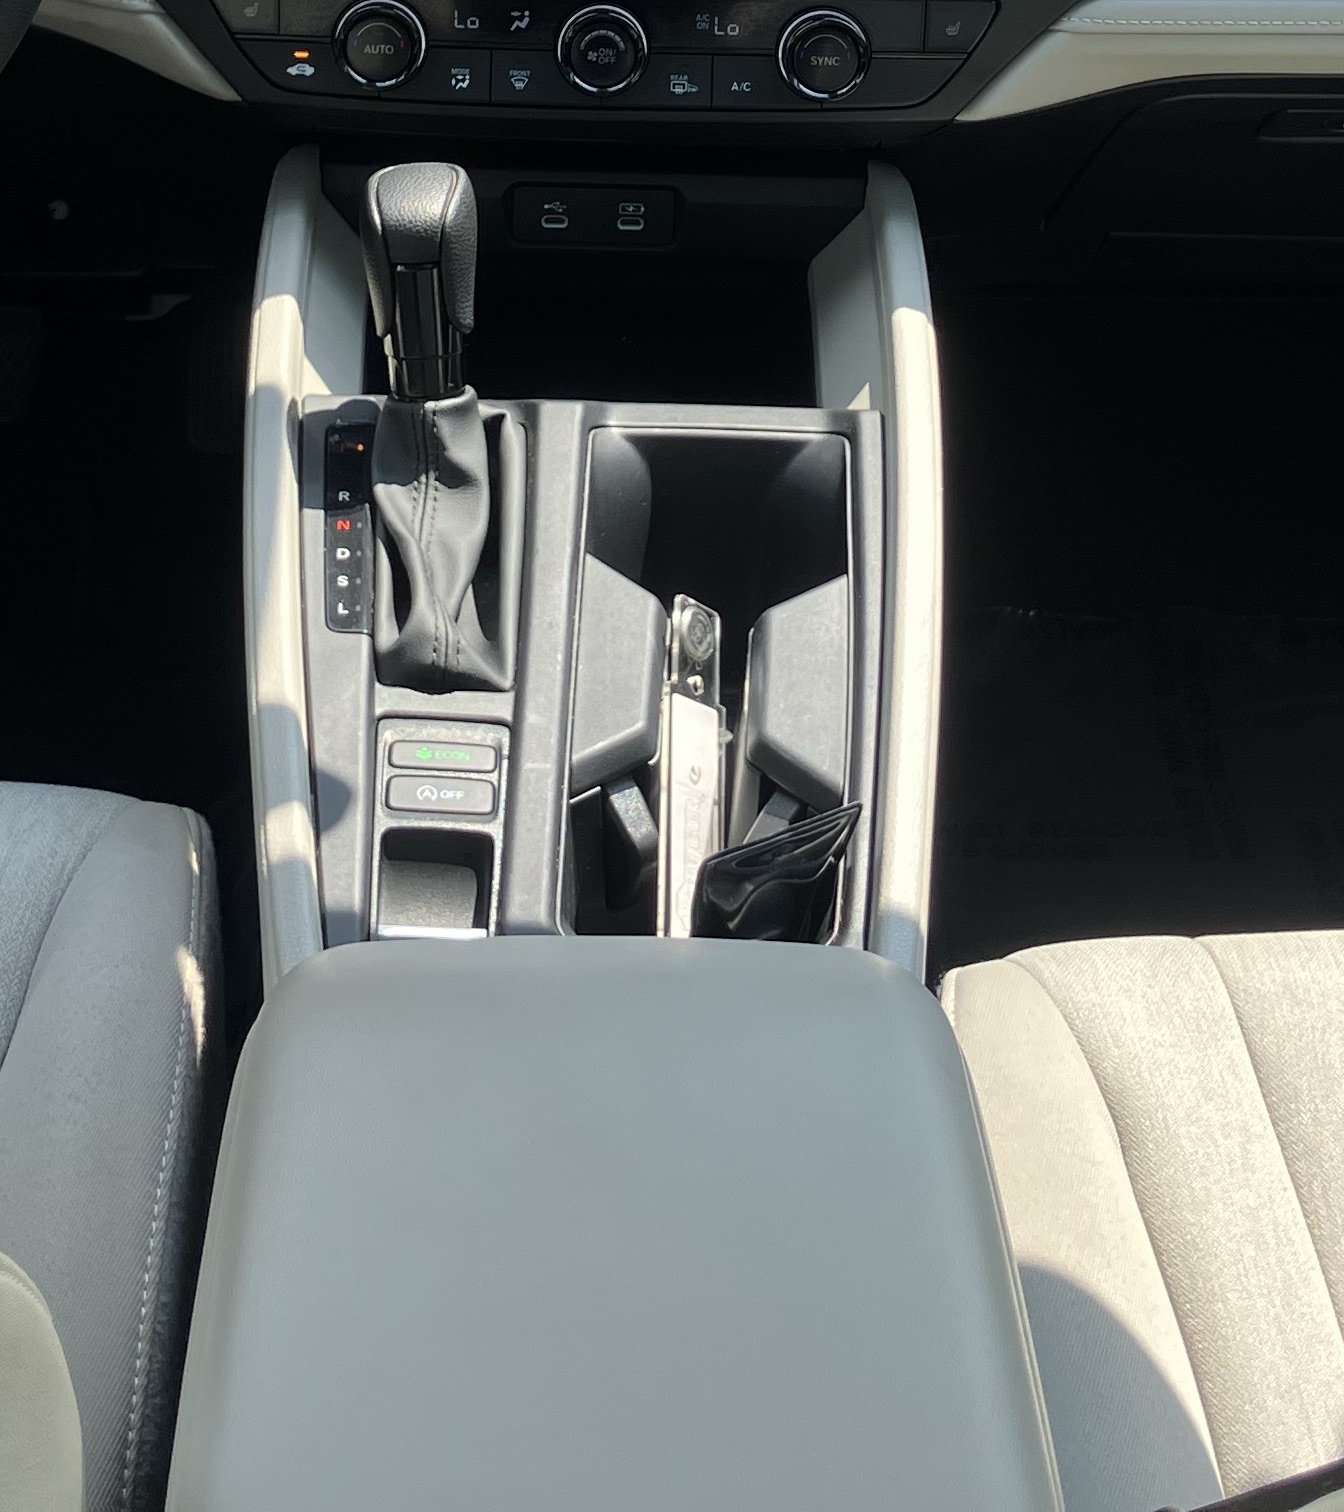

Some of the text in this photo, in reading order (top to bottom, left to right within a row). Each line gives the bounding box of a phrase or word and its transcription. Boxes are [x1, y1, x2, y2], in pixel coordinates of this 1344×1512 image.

[696, 14, 710, 22] A/C
[696, 22, 710, 30] ON
[363, 43, 395, 55] AUTO
[810, 56, 841, 68] SYNC
[731, 81, 752, 92] A/C
[338, 491, 350, 502] R
[336, 519, 352, 531] N
[336, 547, 351, 559] D
[336, 575, 349, 587] S
[336, 602, 349, 615] L
[434, 750, 471, 762] ECON
[440, 789, 465, 800] OFF
